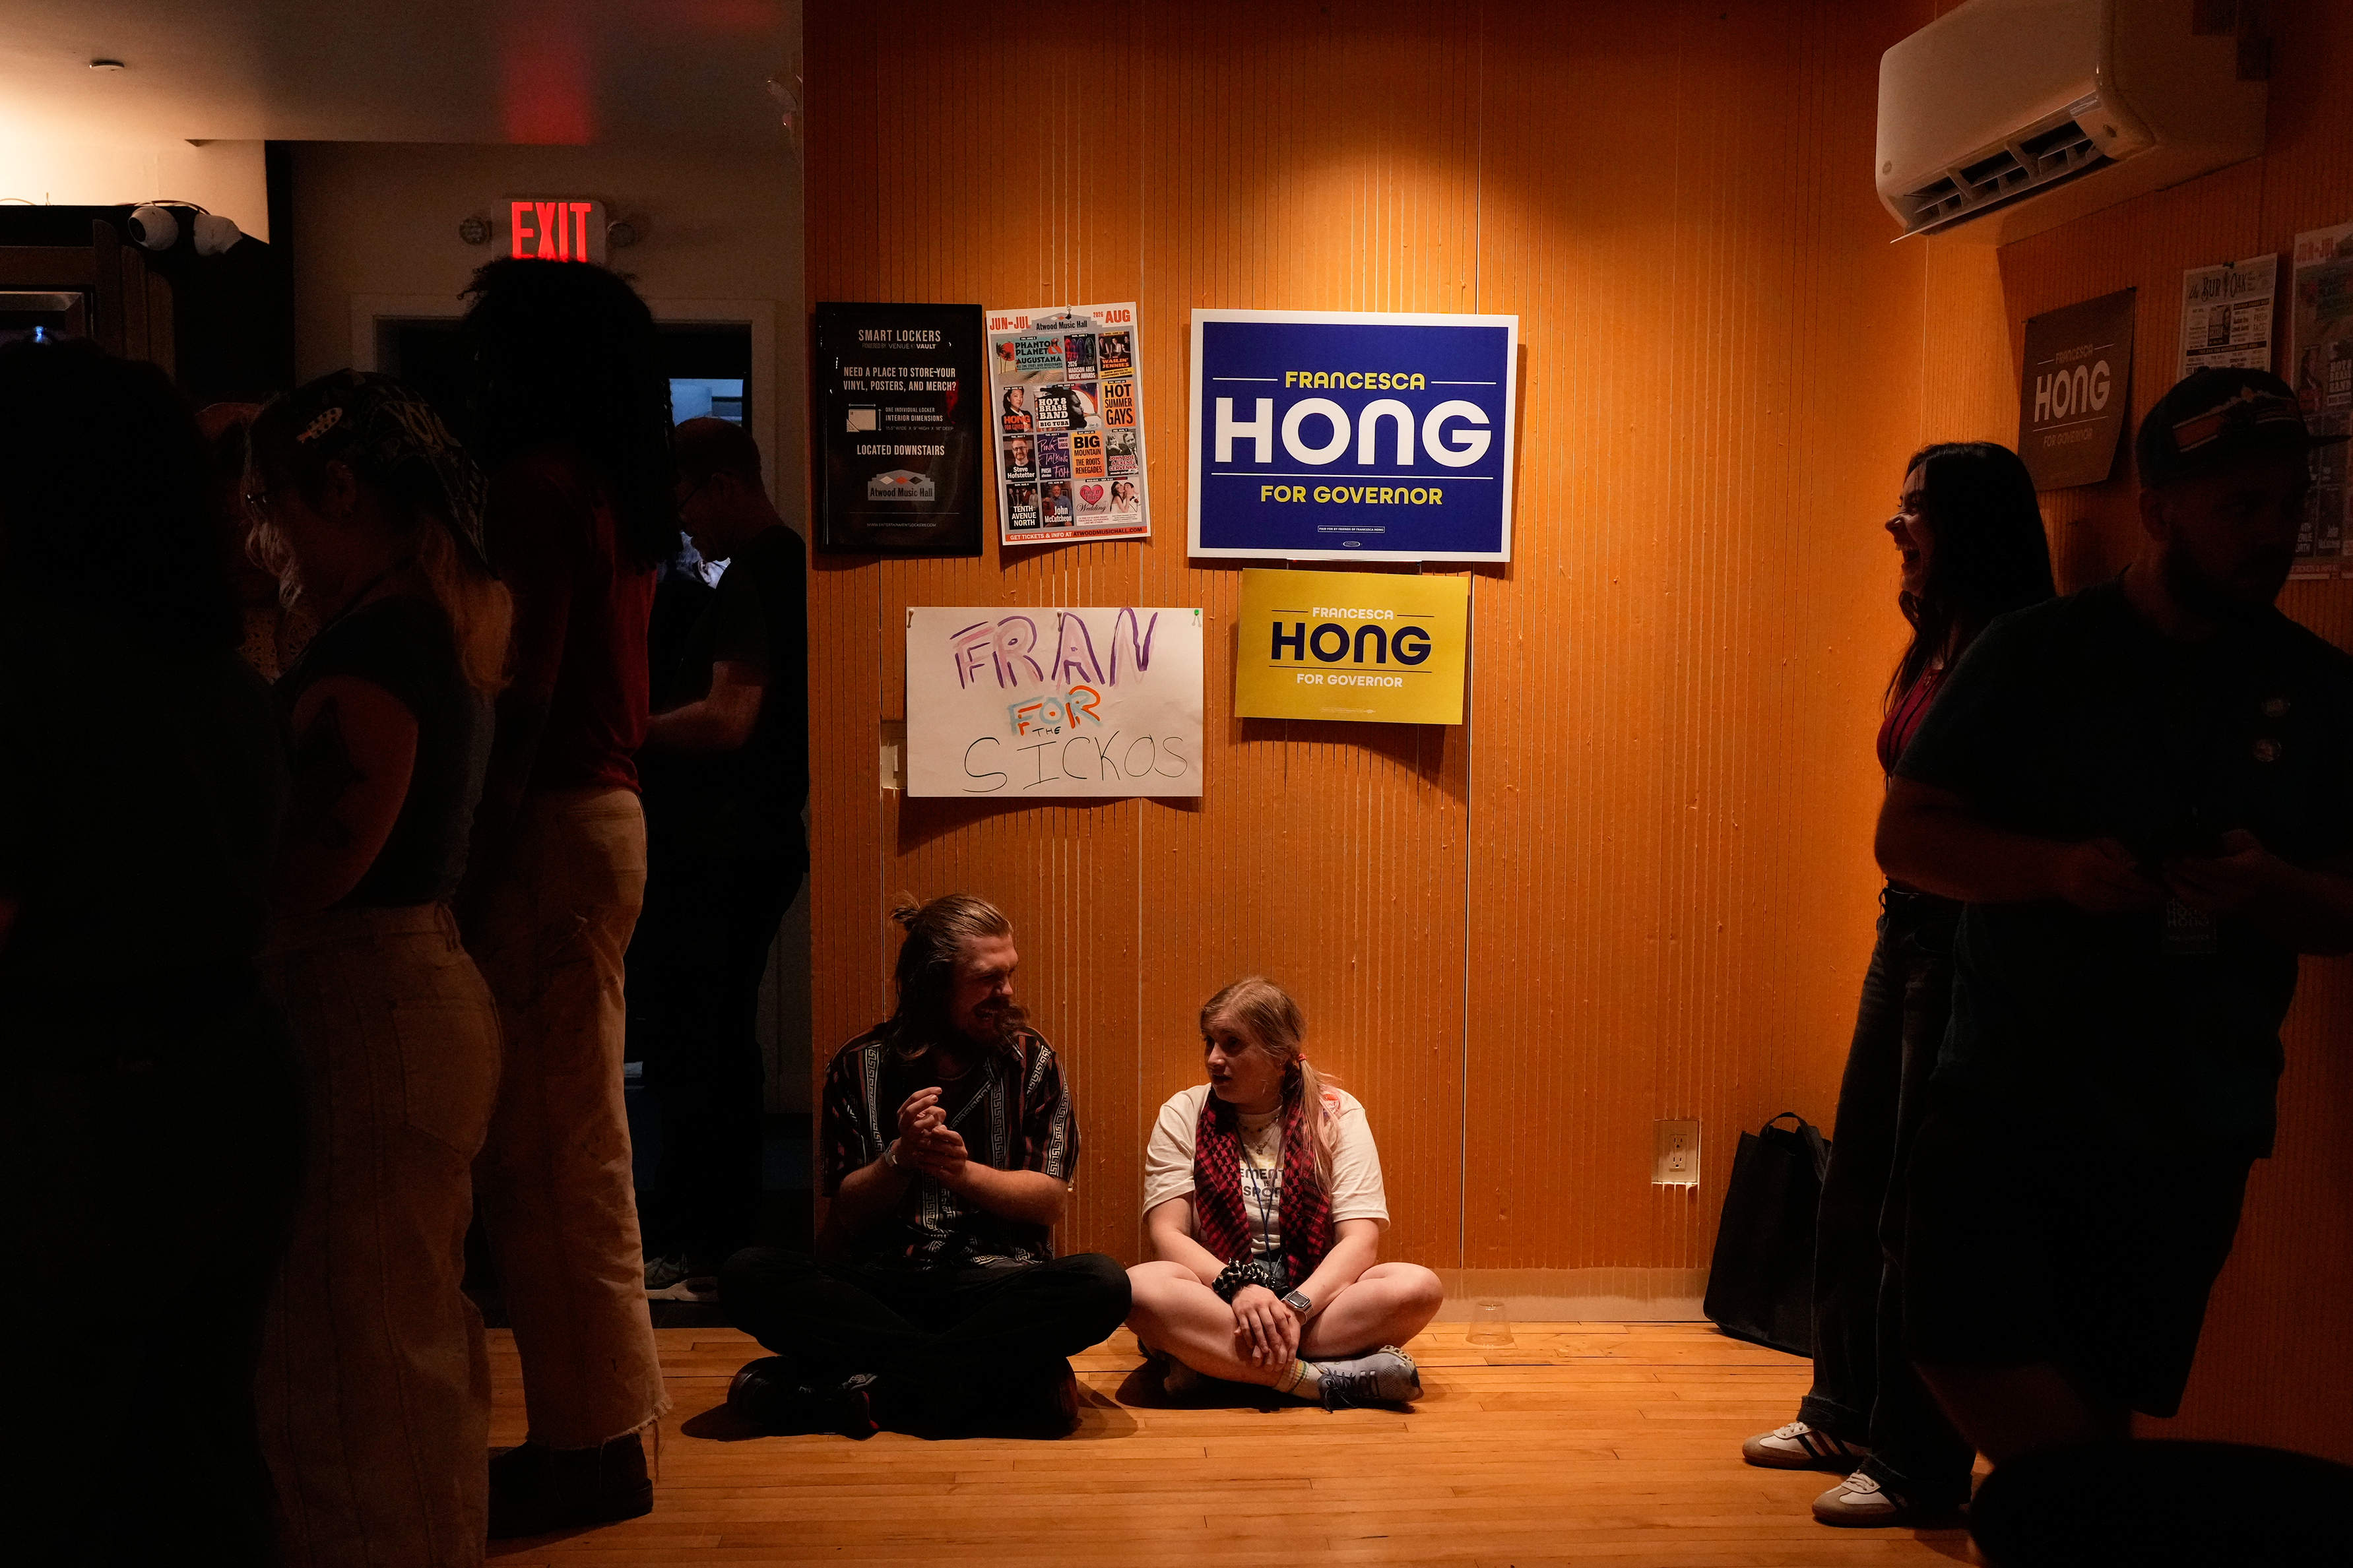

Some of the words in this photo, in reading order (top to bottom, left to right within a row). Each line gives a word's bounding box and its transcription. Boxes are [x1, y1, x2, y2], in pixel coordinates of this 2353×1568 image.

[511, 201, 592, 263] EXIT
[1105, 309, 1131, 323] AUG
[990, 316, 1031, 330] JUN-JUL
[858, 329, 892, 342] SMART
[896, 330, 941, 342] LOCKERS
[1015, 340, 1058, 349] PHANTOM
[1015, 348, 1048, 356] PLANET
[1015, 356, 1062, 364] AUGUSTANA
[843, 367, 863, 377] NEED
[865, 367, 870, 377] A
[872, 367, 896, 377] PLACE
[898, 367, 908, 377] TO
[910, 367, 934, 377] STORE
[936, 367, 955, 378] YOUR
[843, 381, 868, 392] VINYL,
[870, 381, 906, 392] POSTERS,
[909, 381, 924, 391] AND
[926, 381, 956, 391] MERCH?
[1285, 371, 1425, 391] FRANCESCA
[1104, 384, 1132, 398] HOT
[2034, 360, 2111, 423] HONG
[1038, 398, 1060, 406] HOT
[1105, 398, 1132, 408] SUMMER
[1004, 414, 1031, 424] HONG
[1039, 411, 1068, 420] BAND
[1106, 408, 1134, 425] GAYS
[1215, 397, 1492, 468] HONG
[1074, 435, 1100, 449] BIG
[856, 445, 891, 455] LOCATED
[894, 445, 945, 456] DOWNSTAIRS
[1075, 466, 1103, 474] RENEGADES
[870, 487, 896, 497] Atwood
[897, 487, 918, 497] Music
[919, 487, 933, 497] Hall
[1260, 485, 1306, 503] FOR
[1313, 486, 1443, 505] GOVERNOR
[1054, 505, 1068, 516] John
[1076, 503, 1107, 513] Wedding
[1073, 527, 1142, 536] ATWOODMUSICHALL.COM
[1312, 607, 1394, 621] FRANCESCA
[950, 607, 1158, 690] FRAN
[1271, 621, 1432, 666] HONG
[1297, 674, 1324, 685] FOR
[1327, 674, 1403, 687] GOVERNOR
[1008, 685, 1103, 736] FOR
[1032, 726, 1062, 737] THE
[962, 730, 1188, 793] SICKOS
